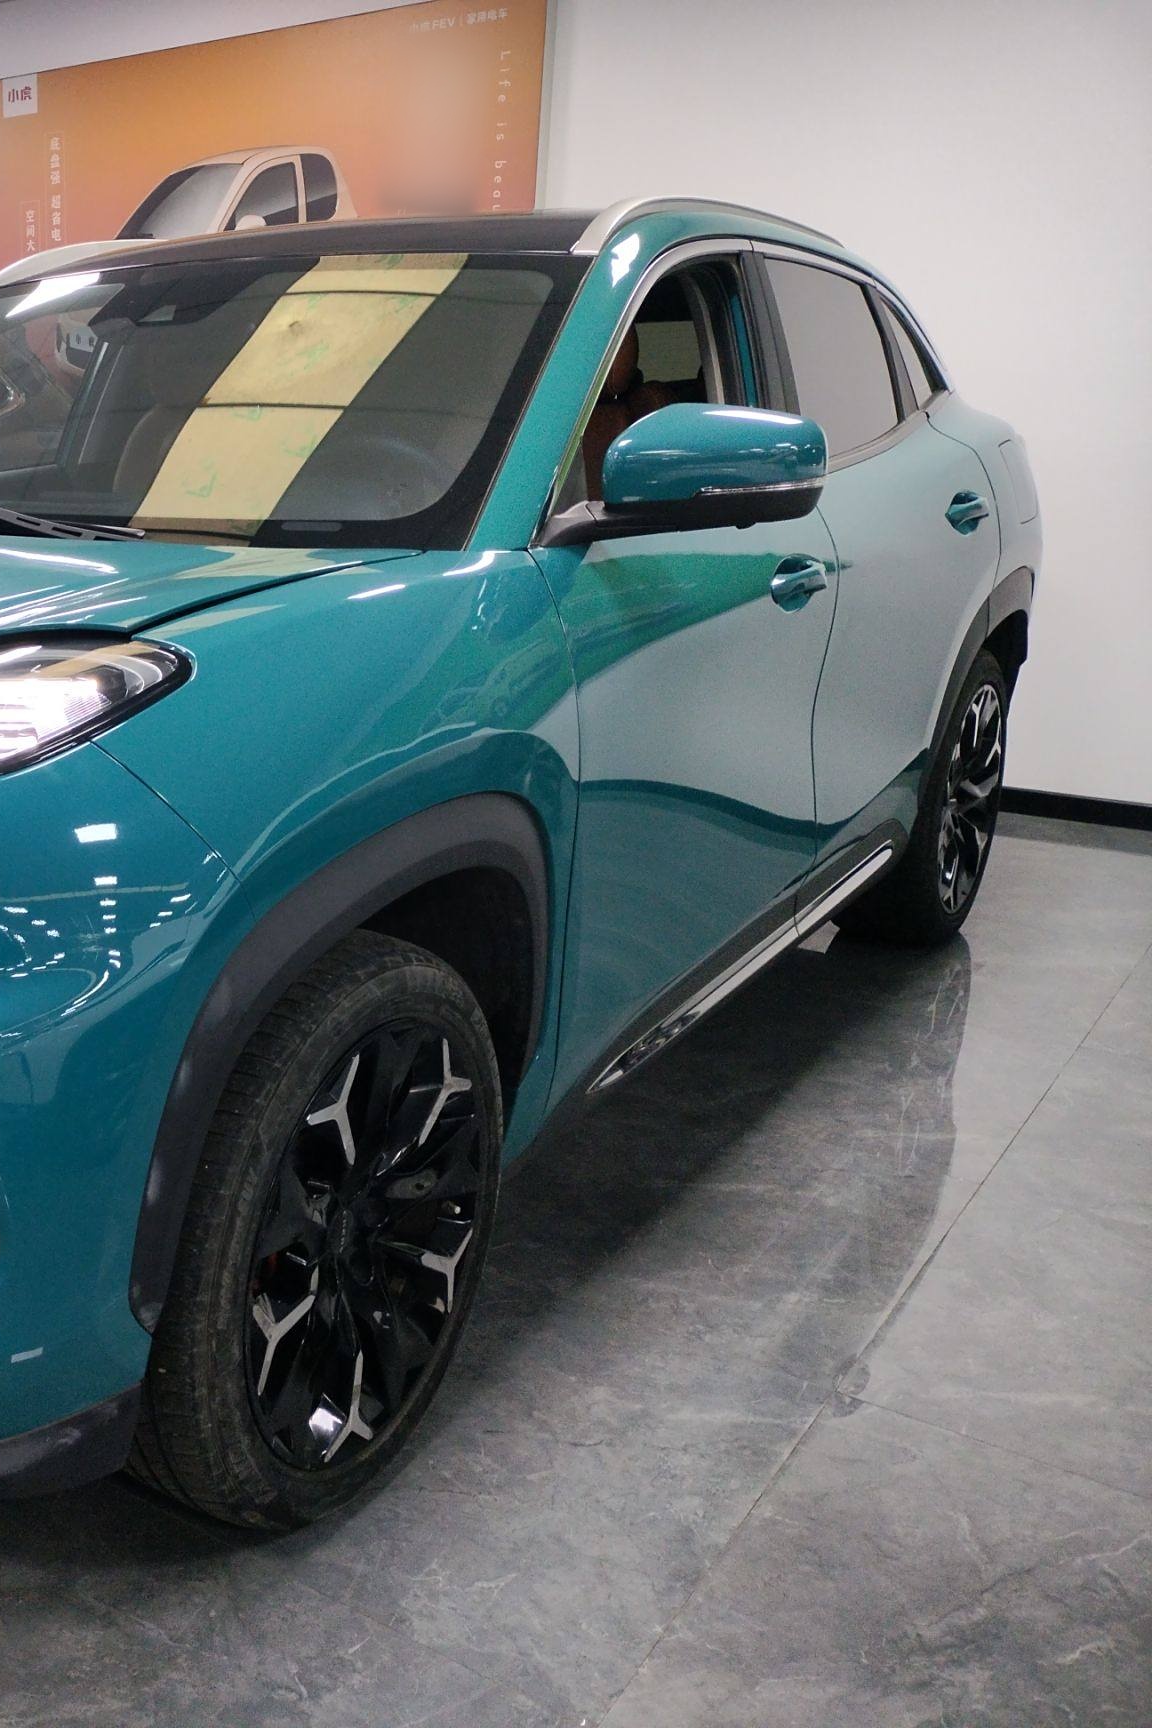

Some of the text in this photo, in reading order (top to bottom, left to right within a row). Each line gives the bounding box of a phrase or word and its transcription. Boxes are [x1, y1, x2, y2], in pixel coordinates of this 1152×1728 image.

[8, 86, 32, 103] 小虎
[499, 51, 512, 102] Life
[496, 122, 508, 141] is
[50, 137, 62, 241] 底盘强 超省电
[25, 210, 36, 251] 空间大
